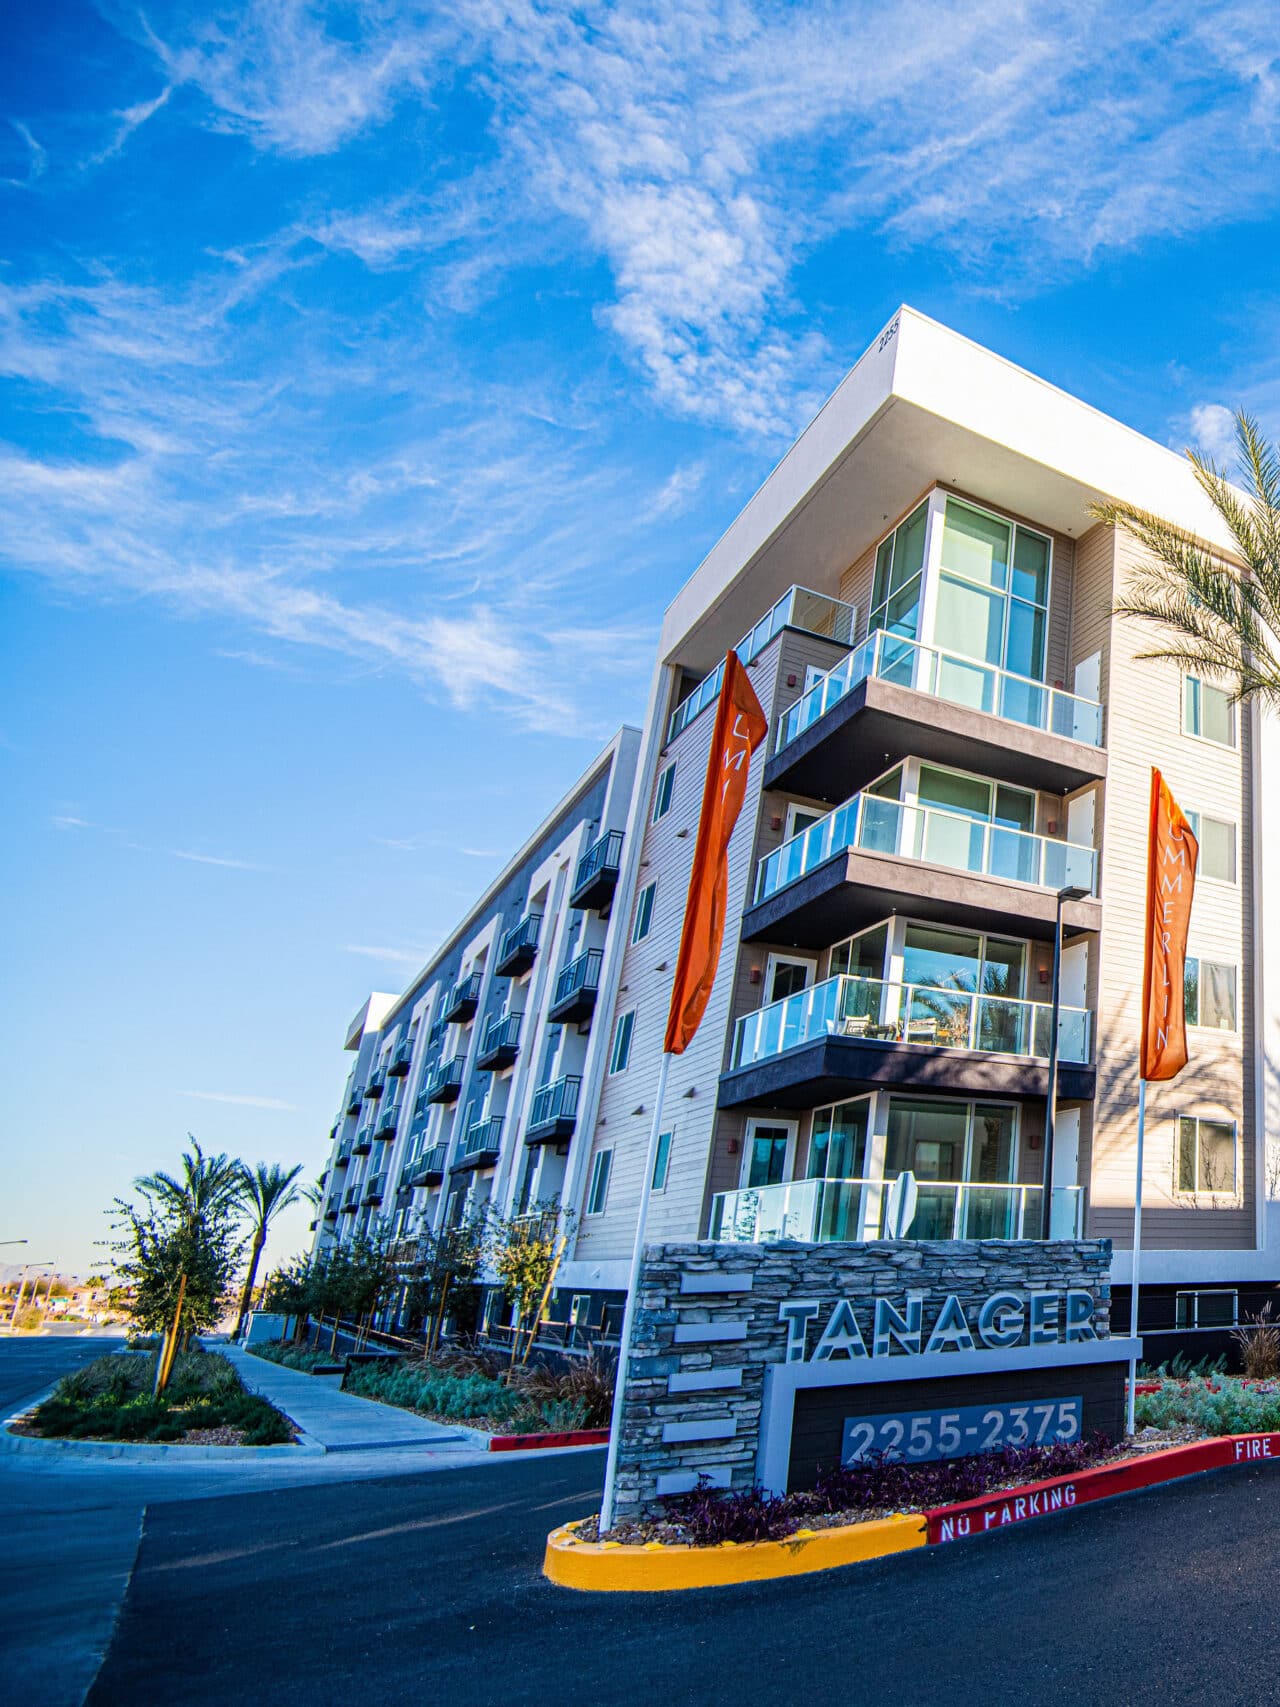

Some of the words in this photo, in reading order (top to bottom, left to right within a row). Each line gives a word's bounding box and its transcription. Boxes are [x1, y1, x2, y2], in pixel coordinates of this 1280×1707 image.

[1156, 818, 1187, 1051] UMMERLIN
[778, 1289, 1100, 1364] TANAGER
[846, 1402, 1079, 1465] 2255-2375
[1235, 1438, 1272, 1460] FIRE
[941, 1514, 970, 1542] NO
